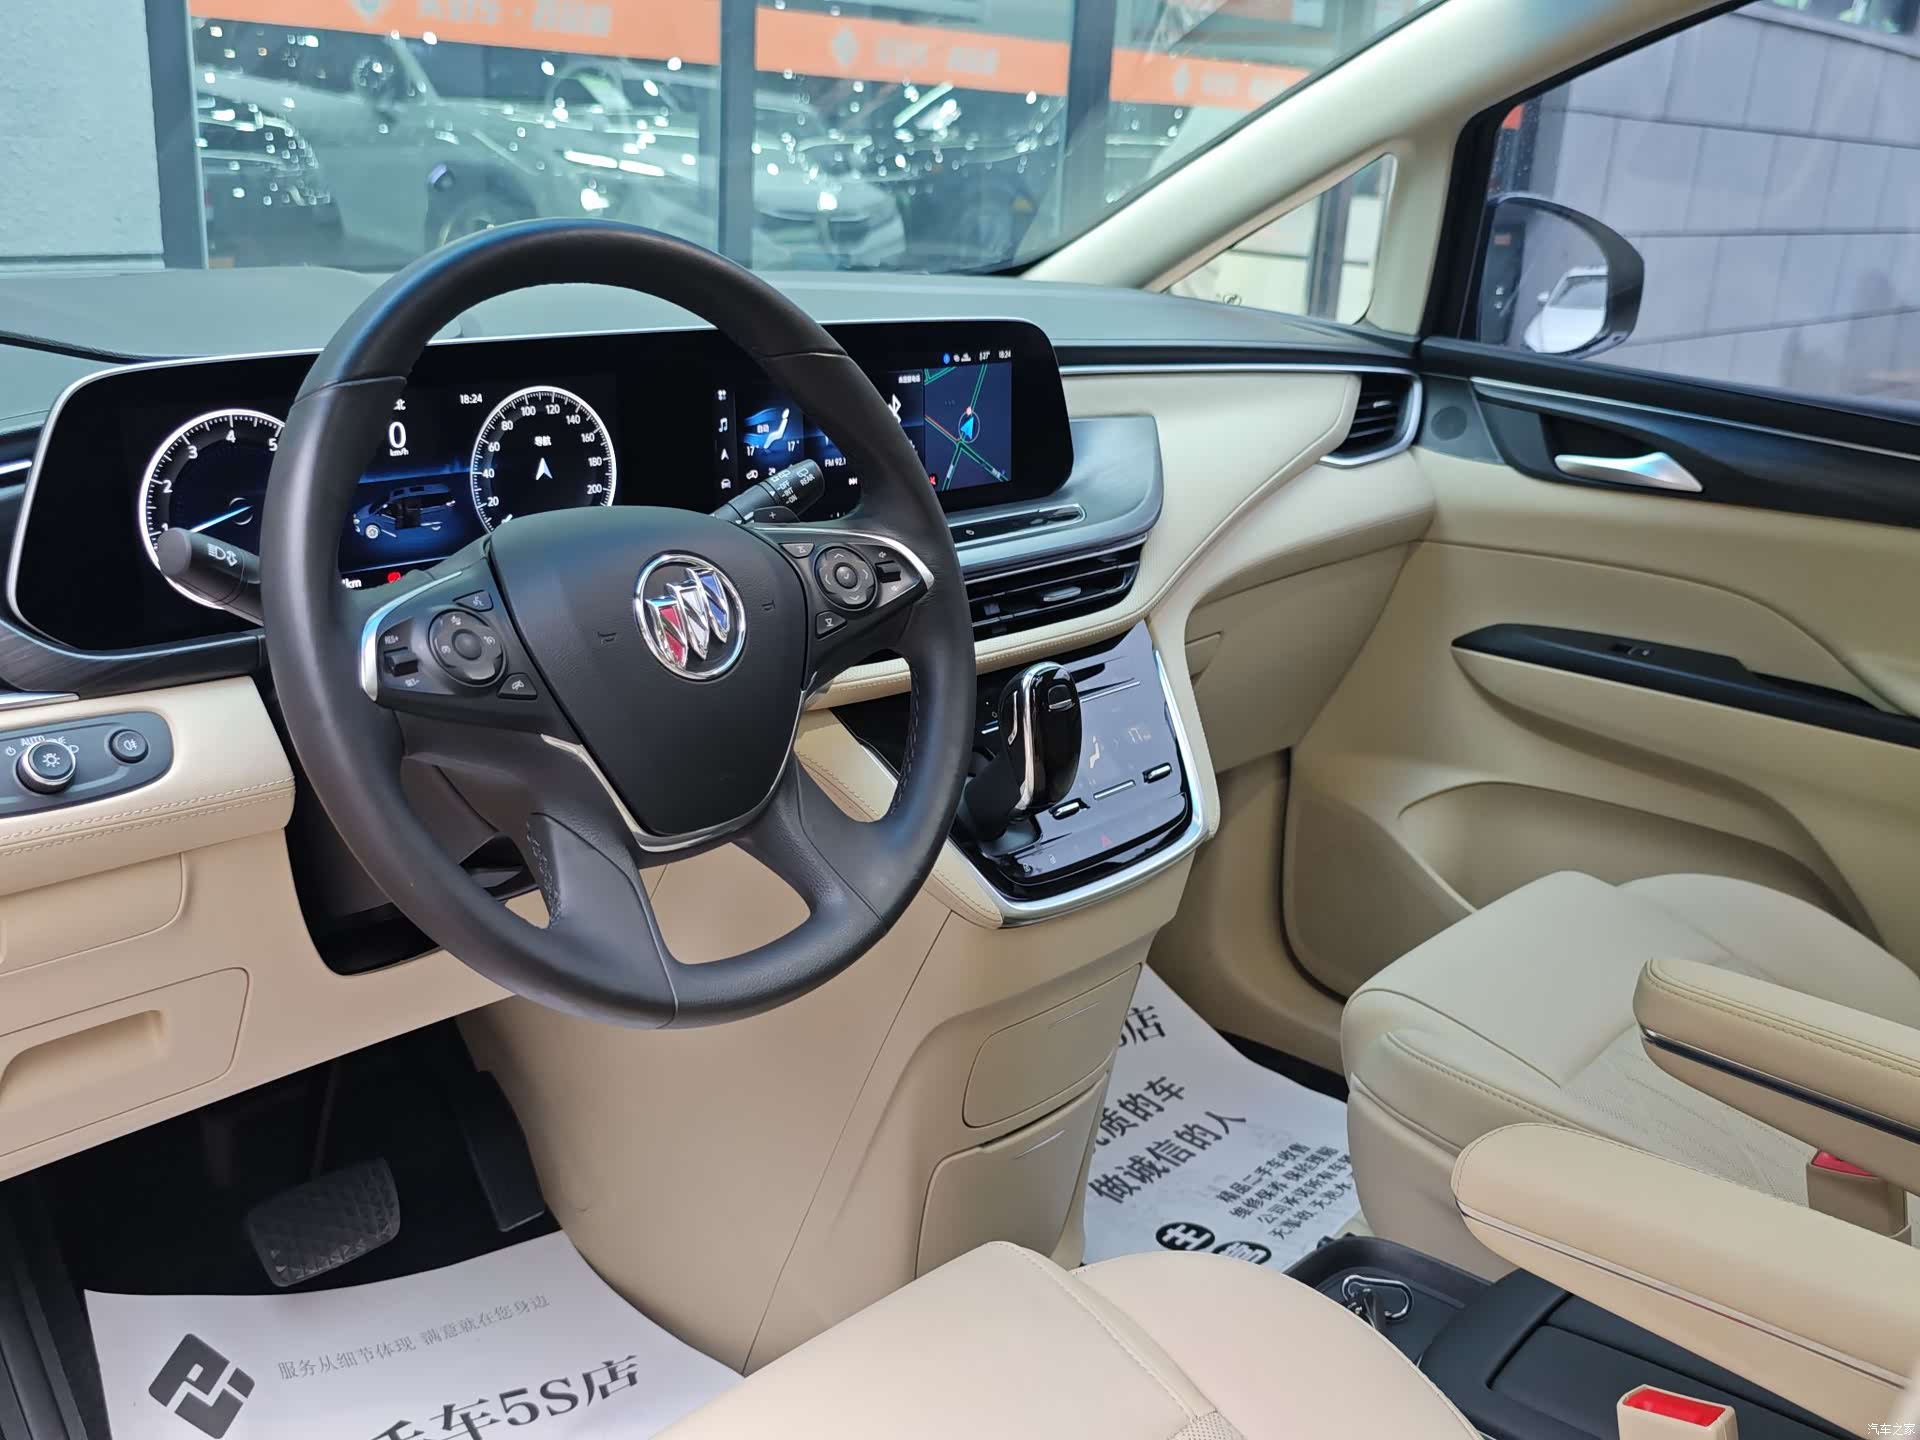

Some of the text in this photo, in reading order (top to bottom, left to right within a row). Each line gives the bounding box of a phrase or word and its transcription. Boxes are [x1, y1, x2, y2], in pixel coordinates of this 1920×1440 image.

[460, 393, 482, 404] 18:24
[520, 405, 536, 417] 100
[545, 404, 561, 415] 120
[566, 414, 581, 425] 140
[501, 420, 514, 431] 80
[225, 429, 236, 443] 4
[389, 421, 406, 448] 0
[581, 432, 595, 443] 160
[268, 438, 278, 452] 5
[488, 441, 500, 452] 60
[188, 445, 198, 459] 3
[389, 447, 409, 456] km/h
[588, 456, 602, 467] 180
[482, 468, 495, 479] 40
[800, 473, 815, 486] REAR
[163, 479, 173, 494] 2
[587, 484, 602, 495] 200
[487, 496, 500, 507] 20
[21, 735, 45, 746] AUTO
[1118, 1005, 1166, 1047] 店
[1096, 1076, 1185, 1146] 质的车
[1088, 1110, 1247, 1204] 做诚信的人
[278, 1294, 550, 1381] 服务从细节体现 满意就在您身边
